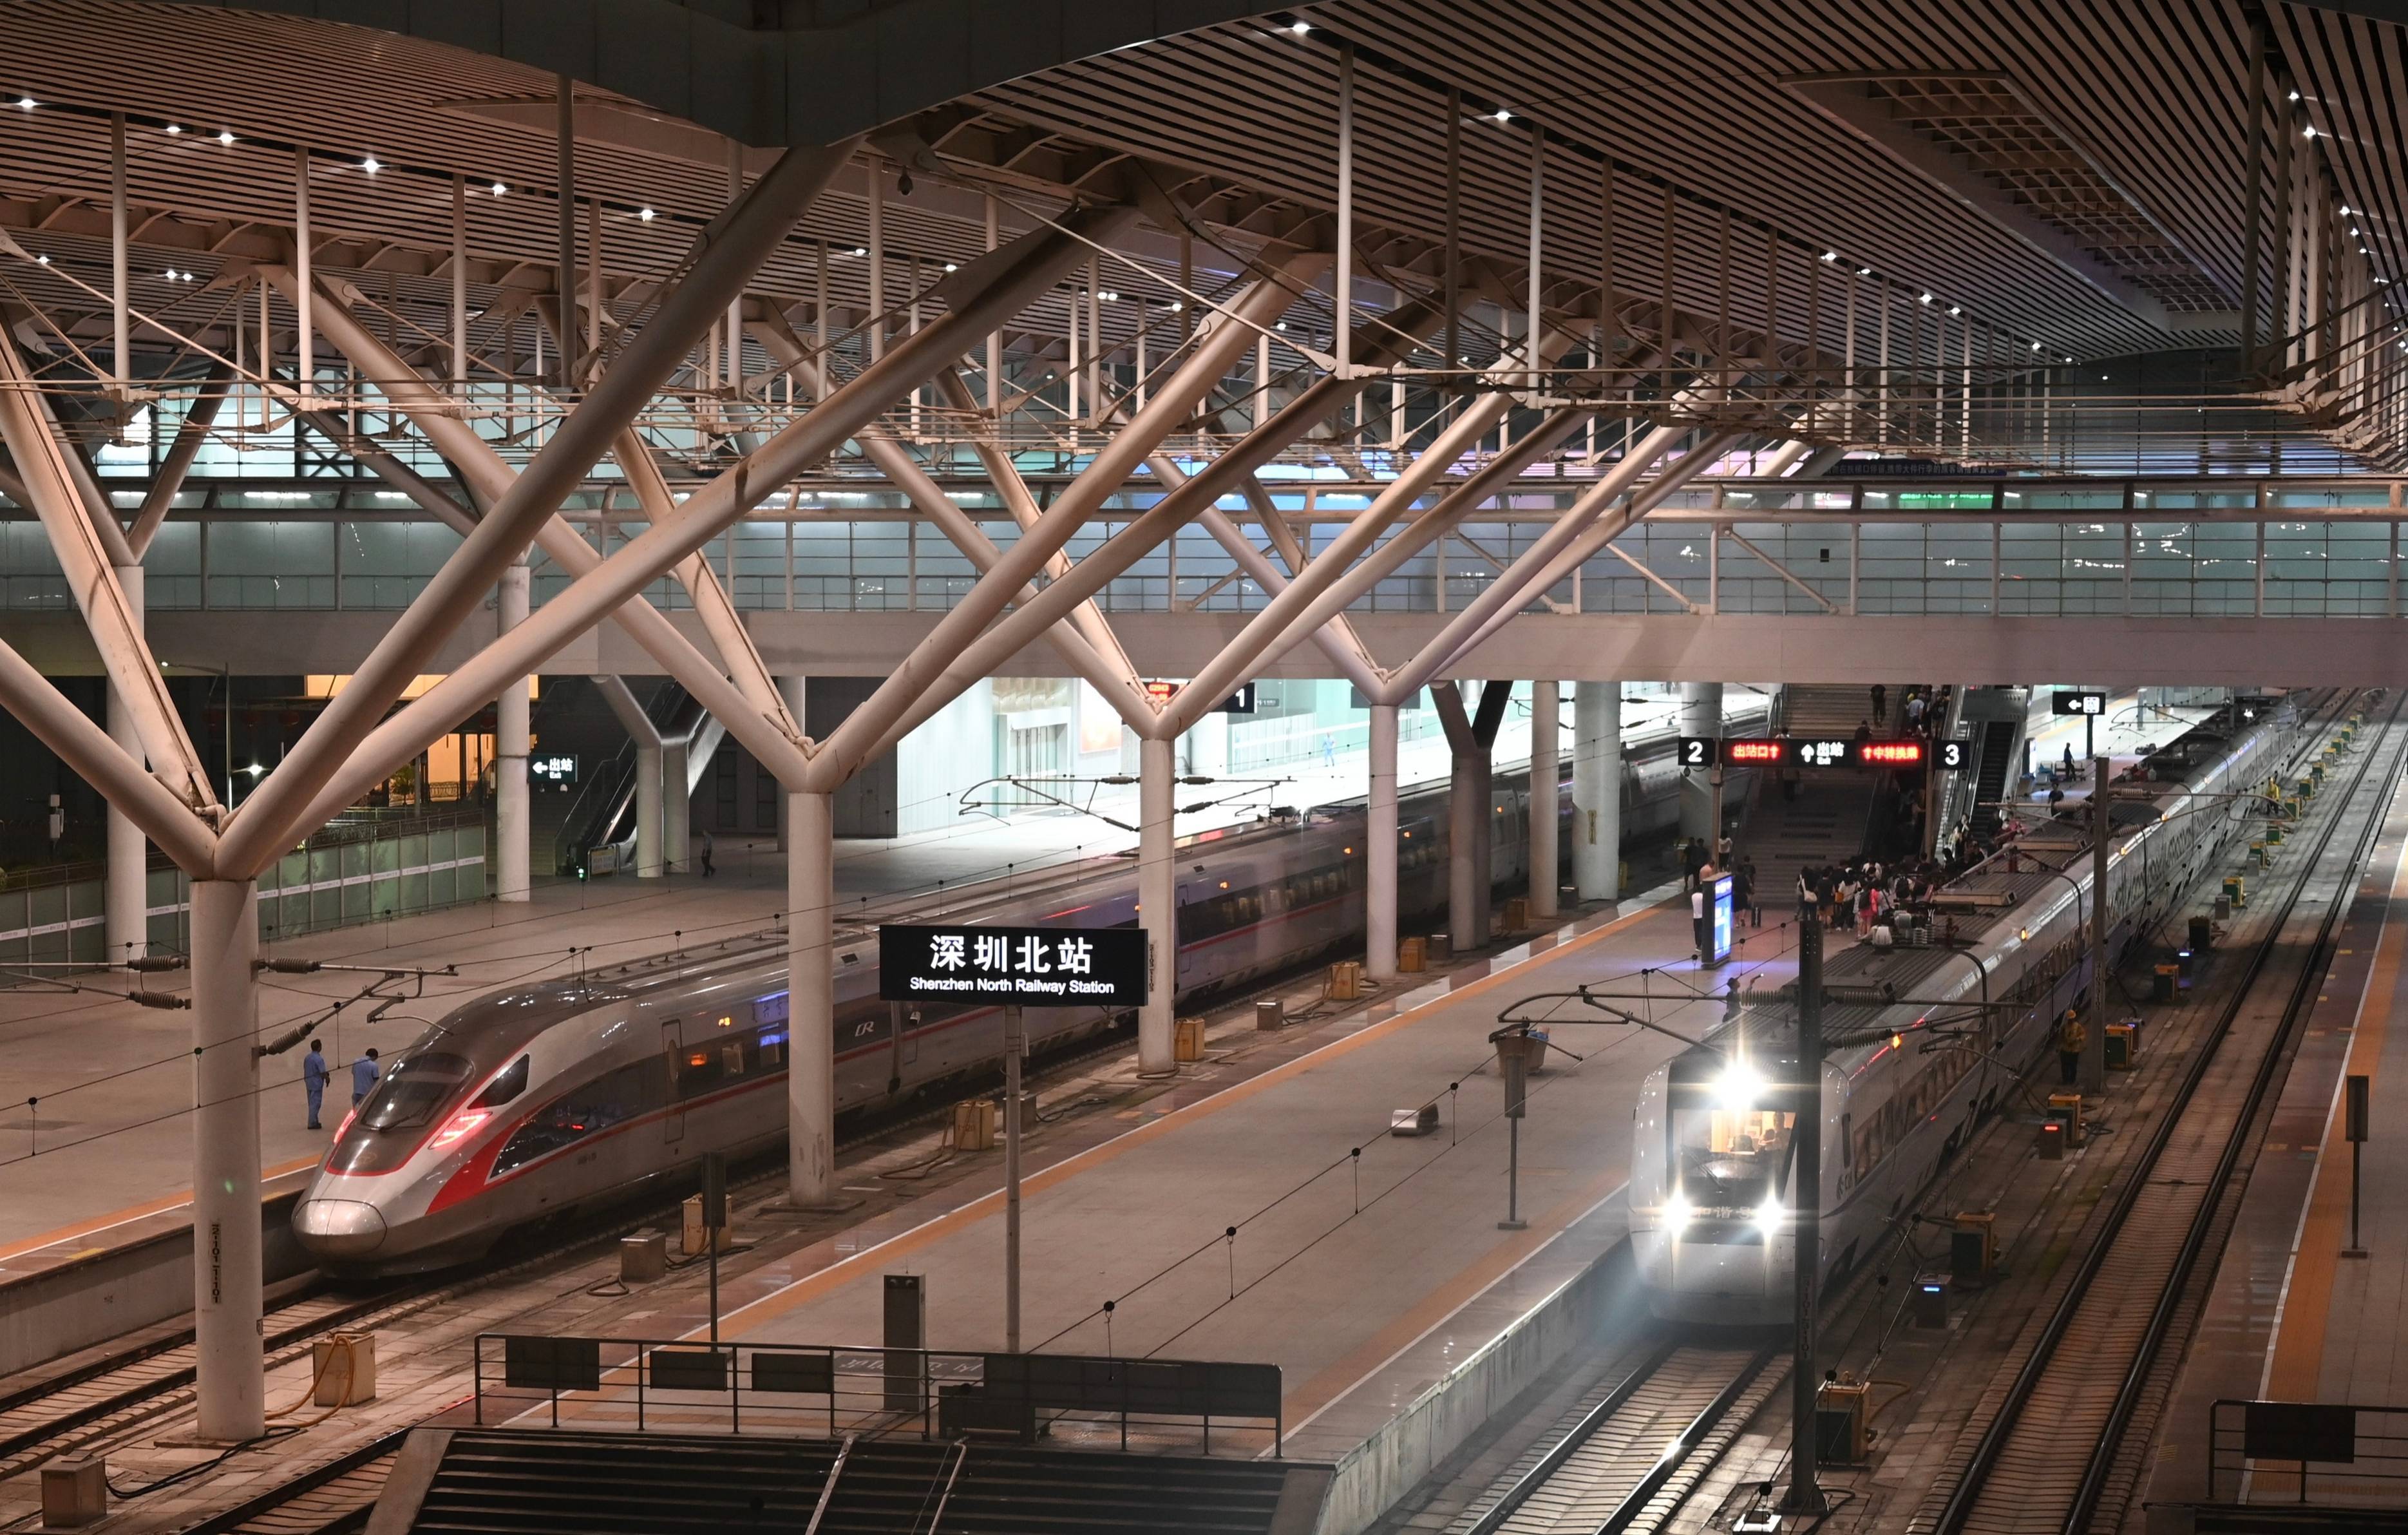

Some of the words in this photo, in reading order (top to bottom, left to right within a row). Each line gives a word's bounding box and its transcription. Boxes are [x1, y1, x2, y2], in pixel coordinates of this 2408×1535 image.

[1235, 688, 1245, 707] 1
[1688, 741, 1703, 762] 2
[1733, 744, 1768, 758] 出站口
[1816, 741, 1844, 757] 出站
[1945, 744, 1960, 765] 3
[549, 758, 573, 772] 出站
[929, 935, 1094, 974] 深圳北站
[909, 977, 974, 991] Shenzhen
[977, 978, 1012, 992] North
[1015, 978, 1067, 996] Railway
[1068, 979, 1115, 994] Station
